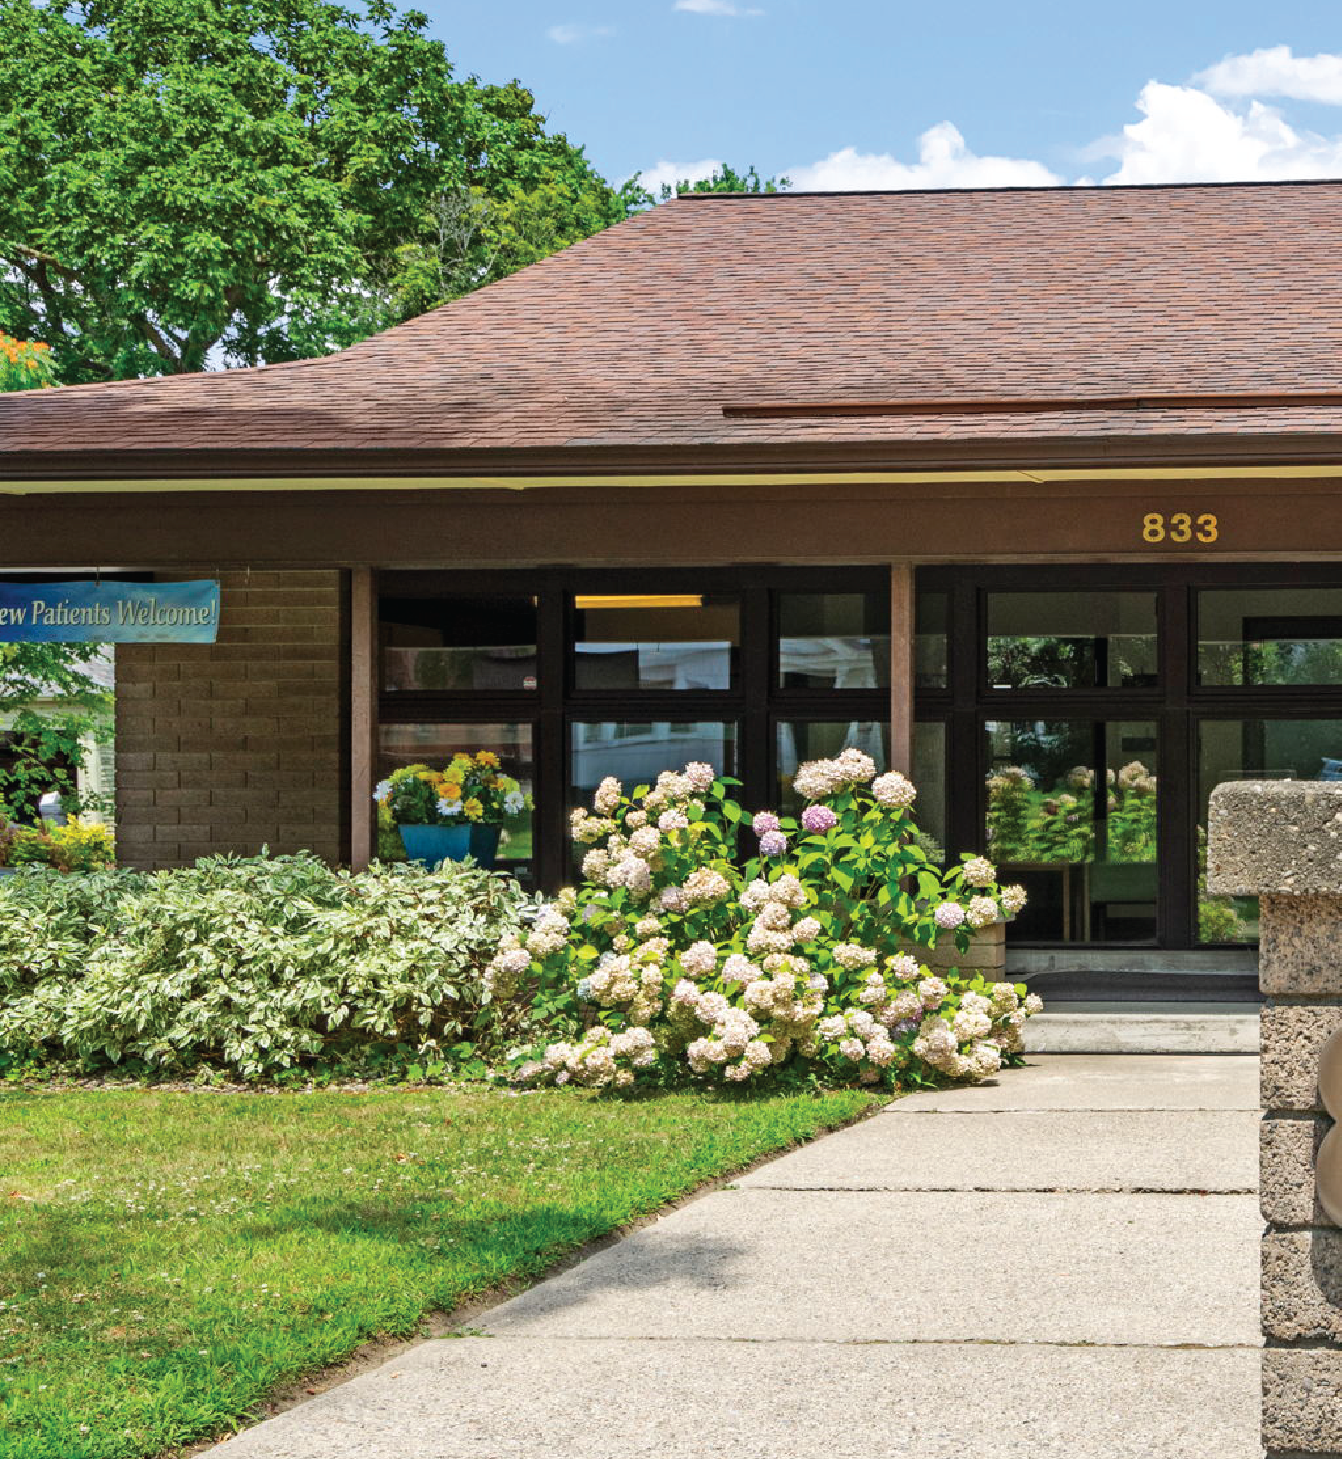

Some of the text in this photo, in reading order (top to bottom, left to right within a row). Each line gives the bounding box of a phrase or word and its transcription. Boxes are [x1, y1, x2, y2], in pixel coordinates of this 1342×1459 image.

[1143, 512, 1218, 542] 833
[31, 598, 111, 626] Patients
[117, 597, 216, 626] Welcome!
